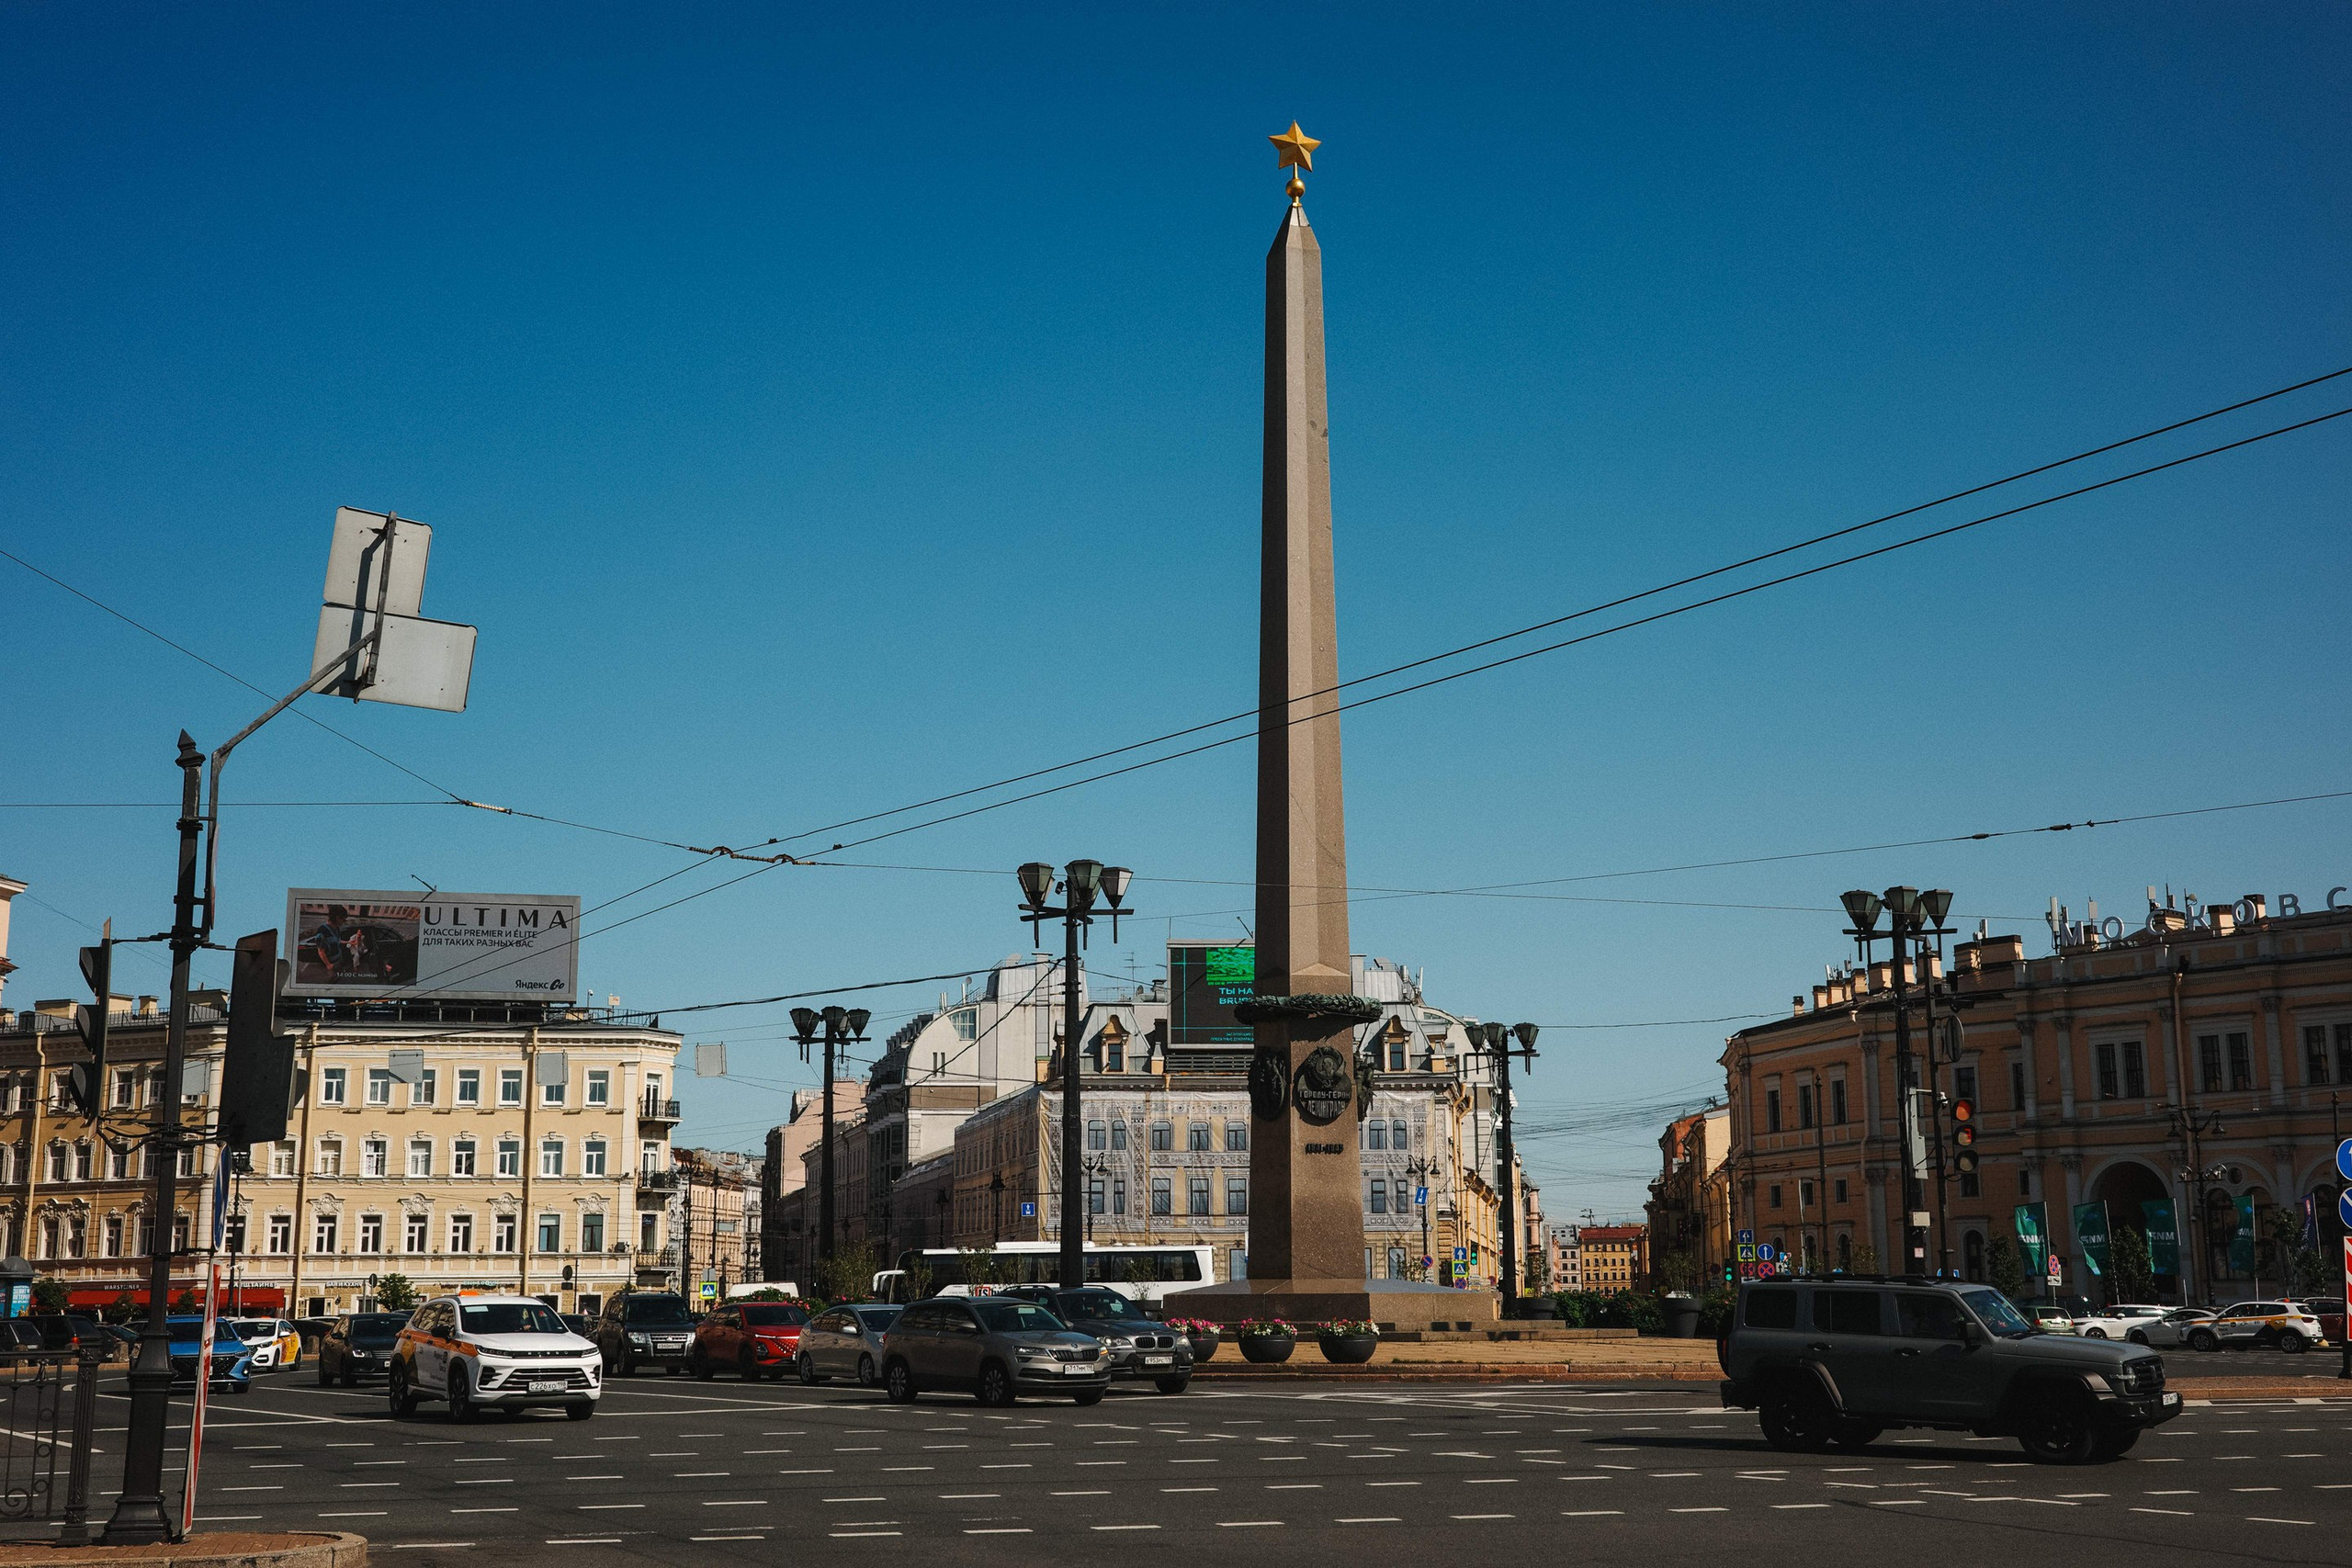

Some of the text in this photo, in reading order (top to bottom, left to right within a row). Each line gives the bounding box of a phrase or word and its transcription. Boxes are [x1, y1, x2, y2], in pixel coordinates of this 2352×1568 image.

[424, 907, 568, 930] ULTIMA
[2060, 886, 2347, 947] МОСКОВС
[423, 928, 462, 937] КЛАССЫ
[464, 929, 503, 938] PREMIER
[514, 929, 537, 939] ÉLITE
[423, 938, 442, 947] ДЛЯ
[445, 939, 474, 947] ТАКИХ
[477, 939, 514, 947] РАЗНЫХ
[515, 979, 565, 990] Яндекс Go
